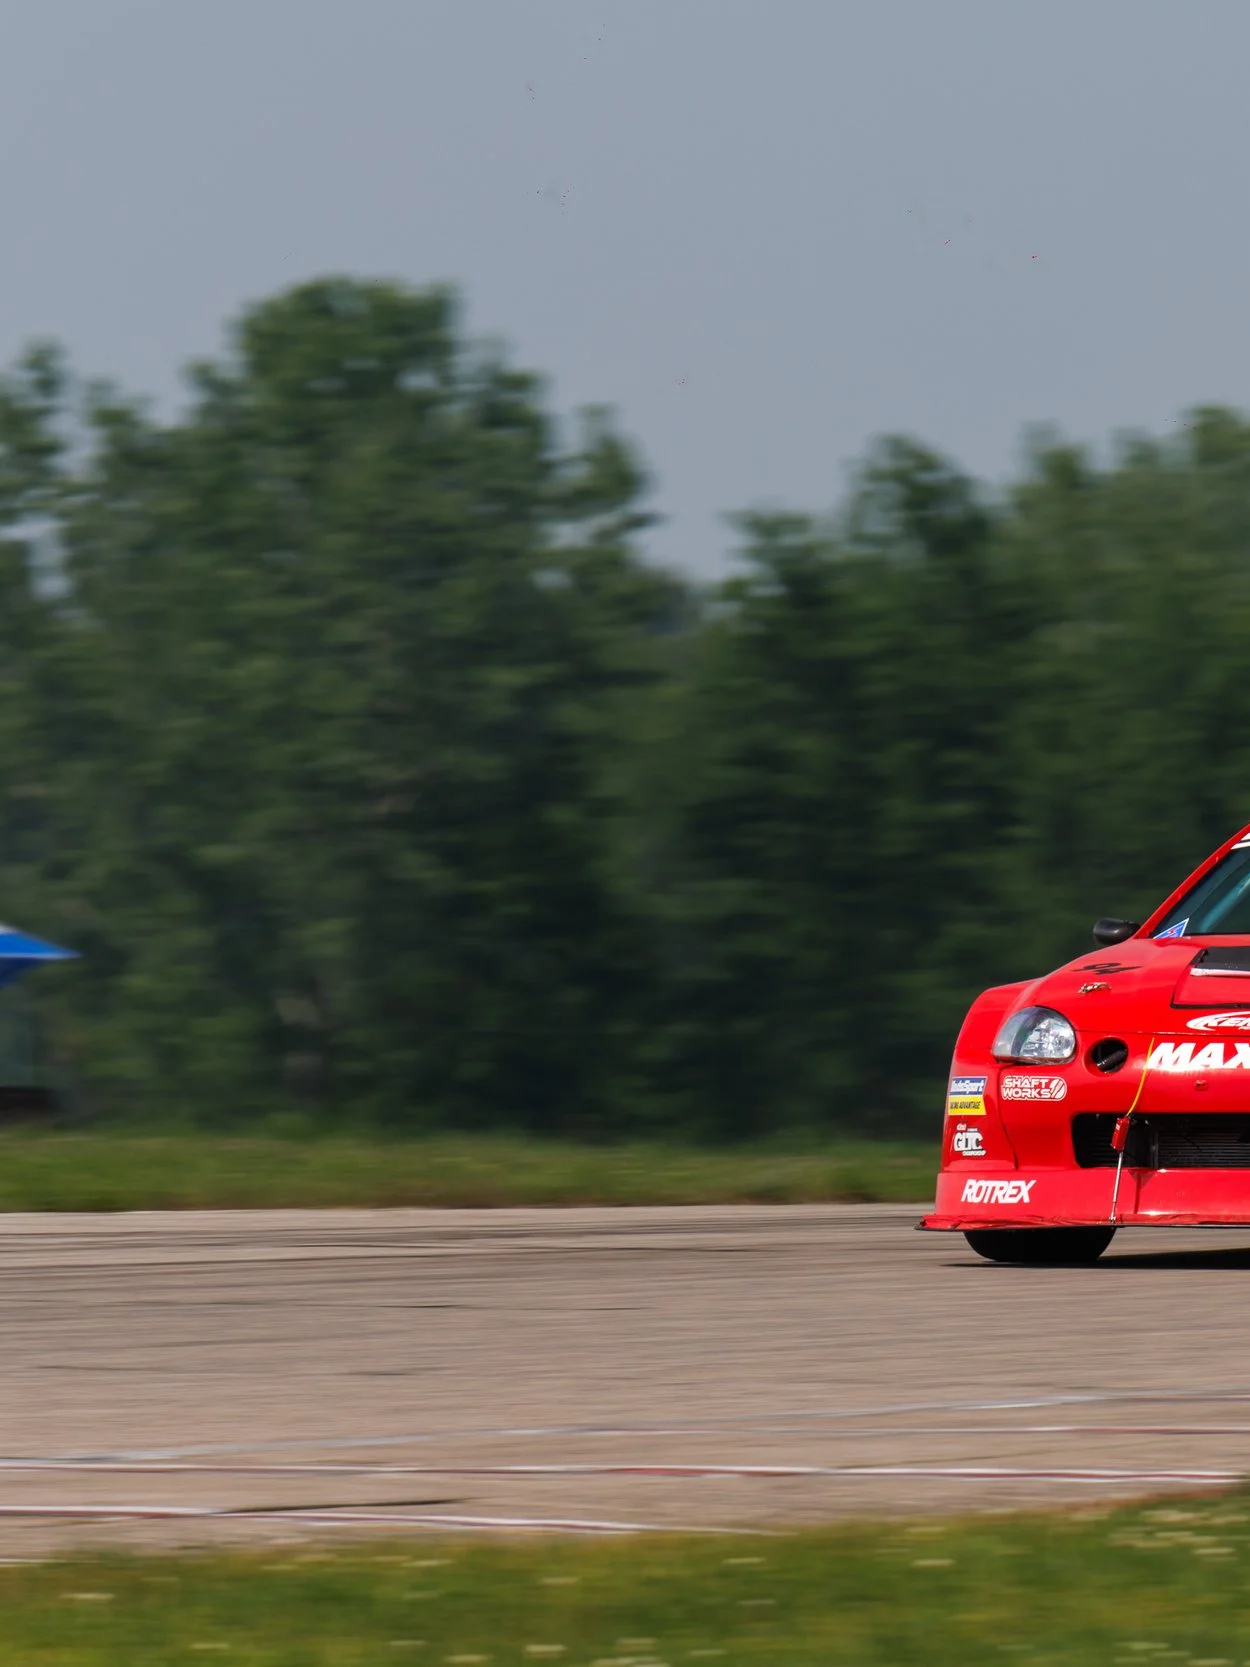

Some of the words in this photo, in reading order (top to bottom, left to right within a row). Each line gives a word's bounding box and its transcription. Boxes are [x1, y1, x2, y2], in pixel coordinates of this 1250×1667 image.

[1002, 1077, 1049, 1089] SHAFT
[1002, 1088, 1050, 1100] WORKS
[961, 1179, 1037, 1204] ROTREX
